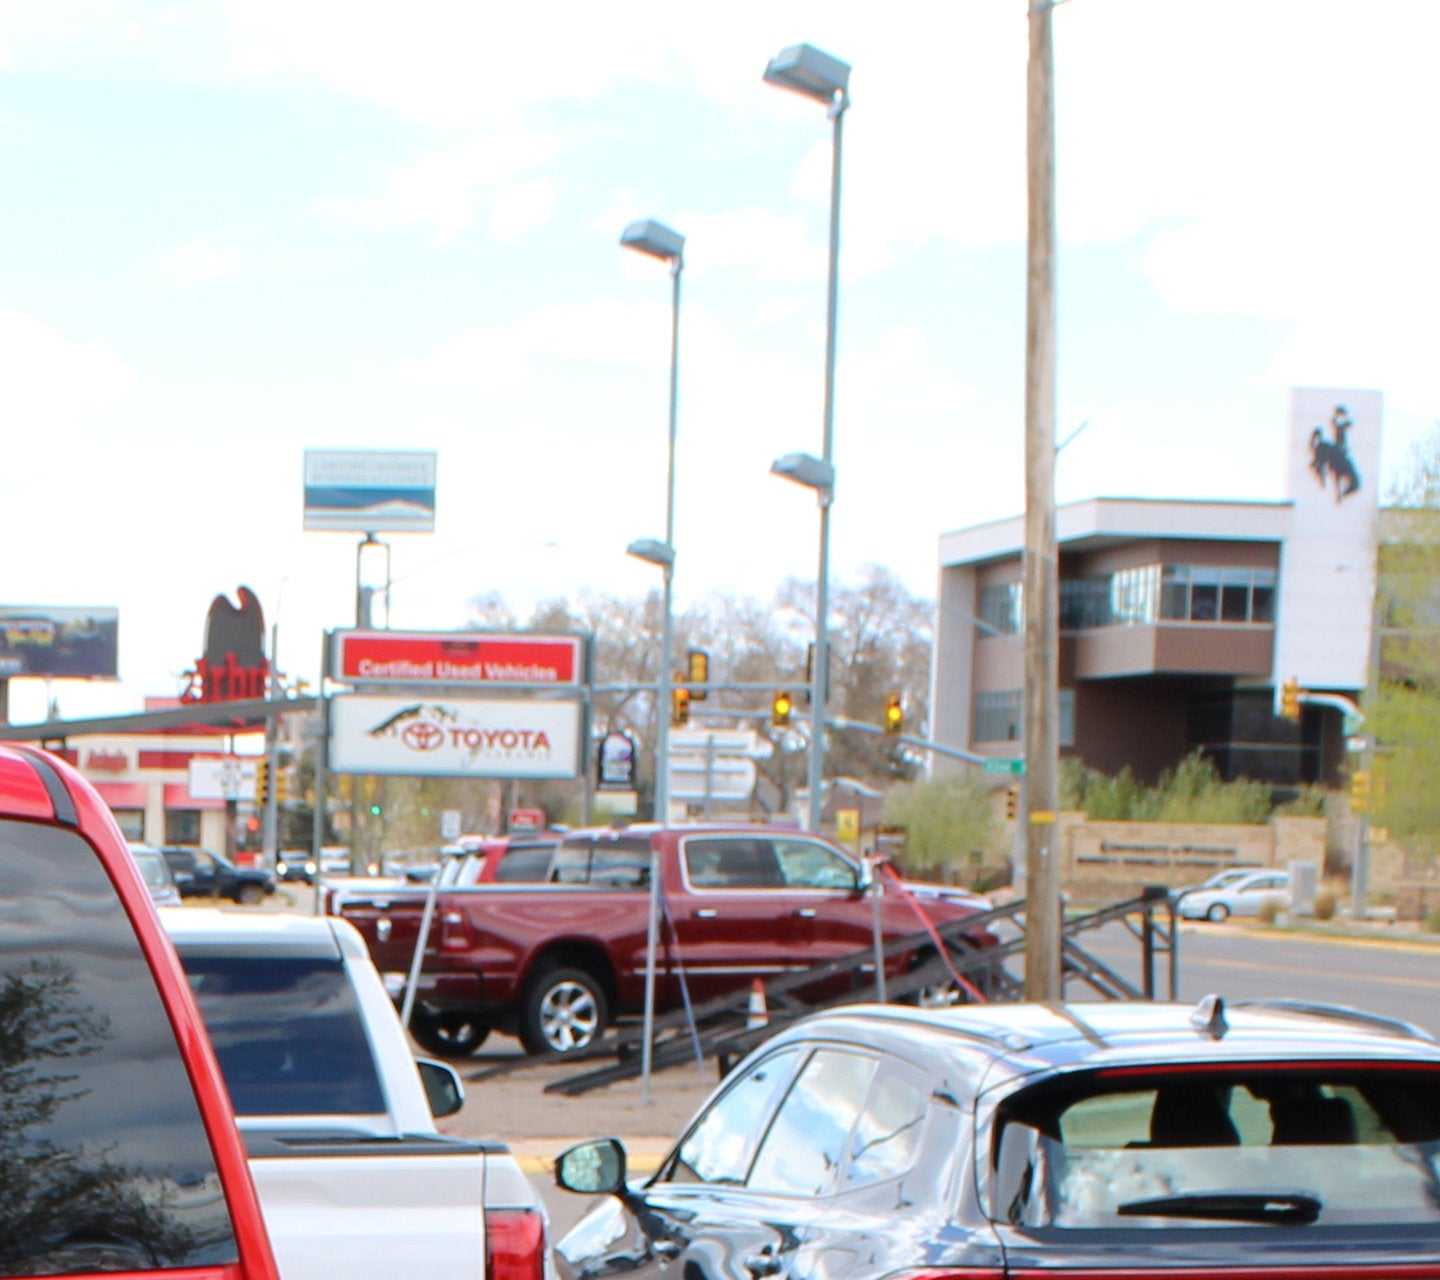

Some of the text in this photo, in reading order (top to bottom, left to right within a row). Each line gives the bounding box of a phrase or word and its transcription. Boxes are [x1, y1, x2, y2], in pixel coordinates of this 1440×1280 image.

[358, 660, 557, 681] Certified Used Vehicles
[448, 728, 551, 750] TOYOTA
